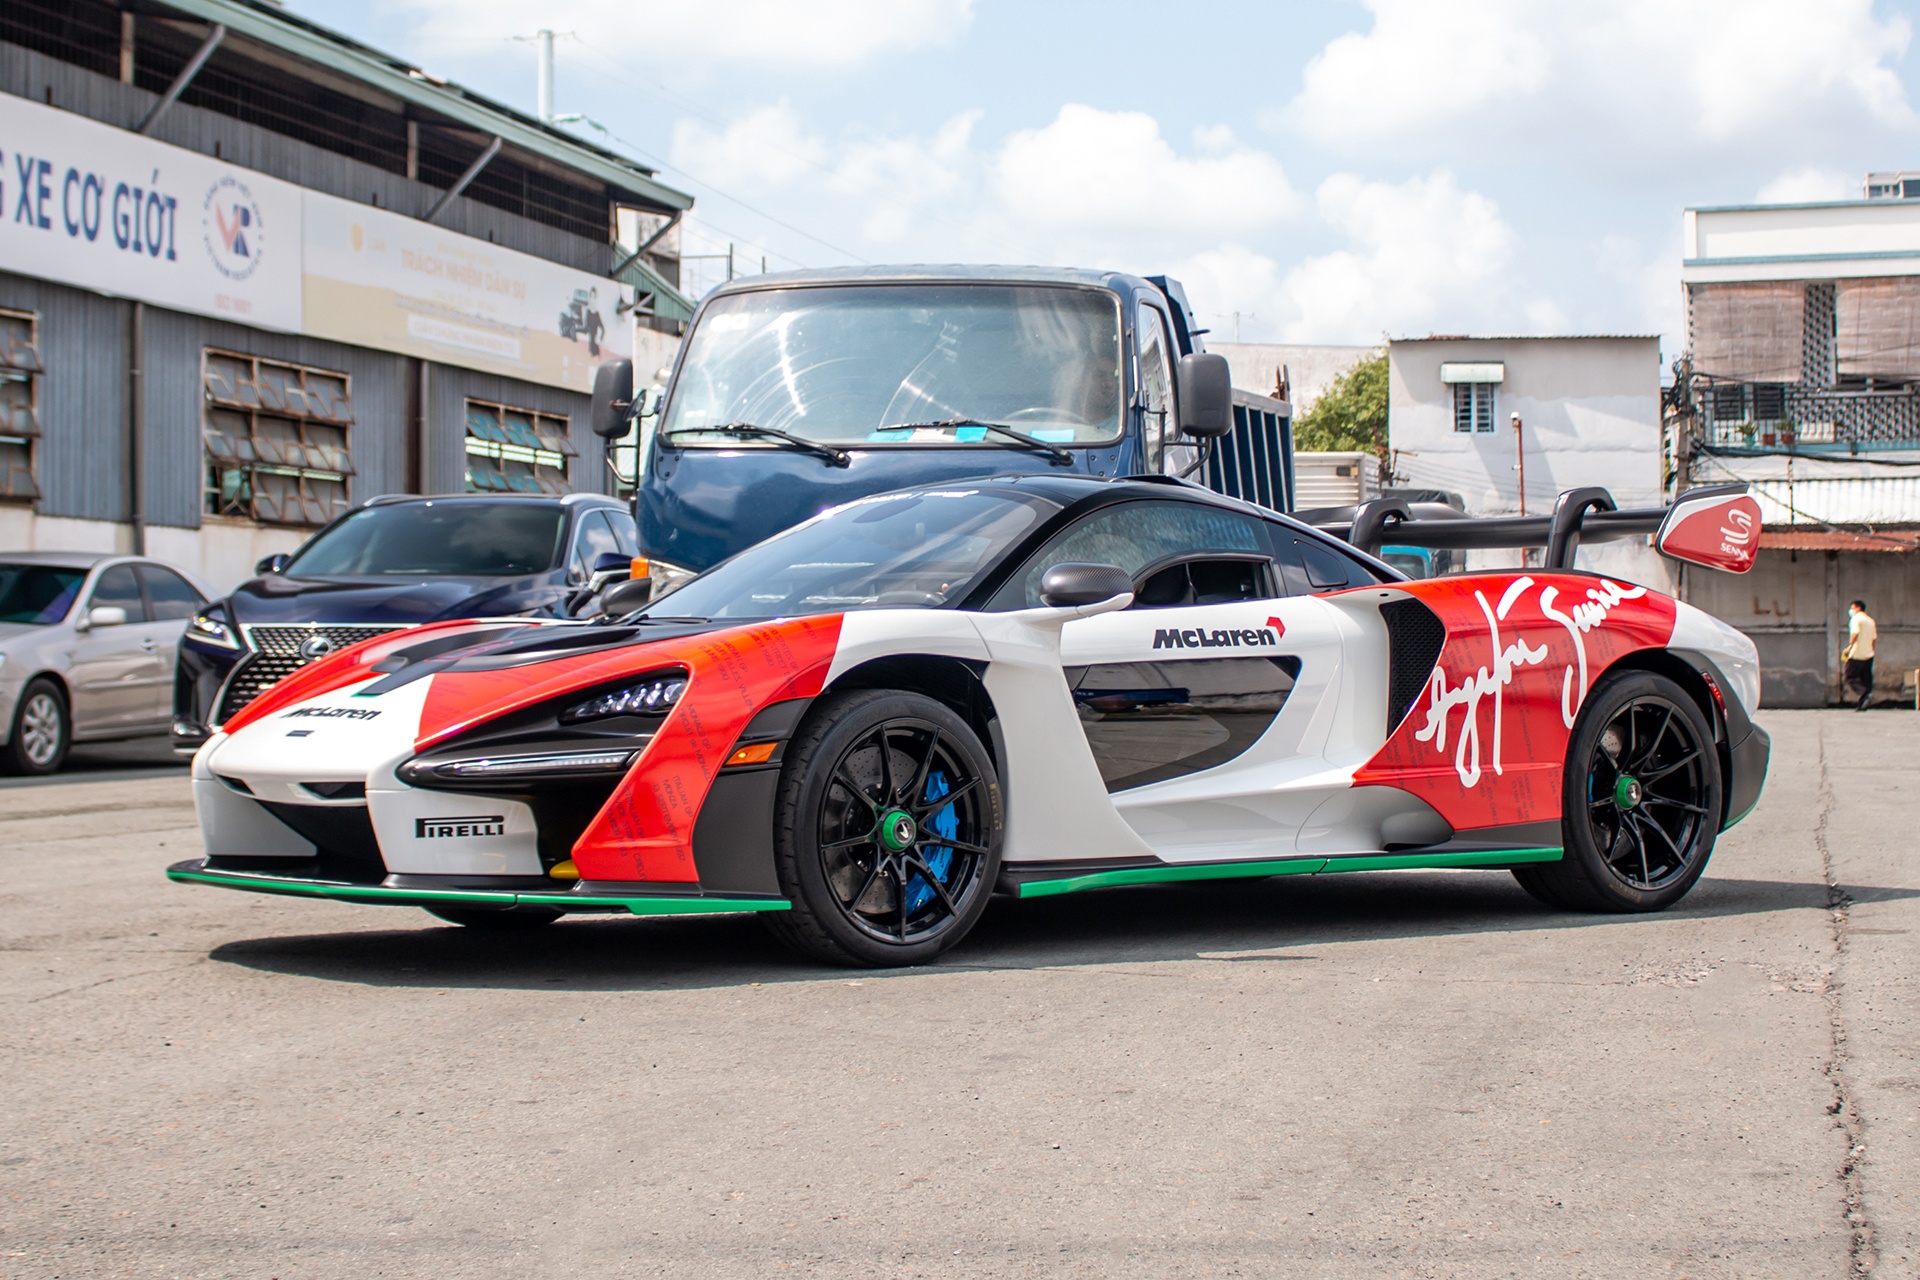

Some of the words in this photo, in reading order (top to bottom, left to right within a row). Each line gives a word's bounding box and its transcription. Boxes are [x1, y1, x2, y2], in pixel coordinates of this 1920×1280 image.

[15, 153, 51, 230] XE
[63, 166, 104, 242] CƠ
[113, 168, 176, 261] GIỚI
[1720, 542, 1750, 561] SENNA
[1152, 627, 1276, 649] McLaren
[279, 706, 382, 721] McLaren
[662, 779, 678, 809] MONZA
[415, 815, 504, 838] PIRELLI
